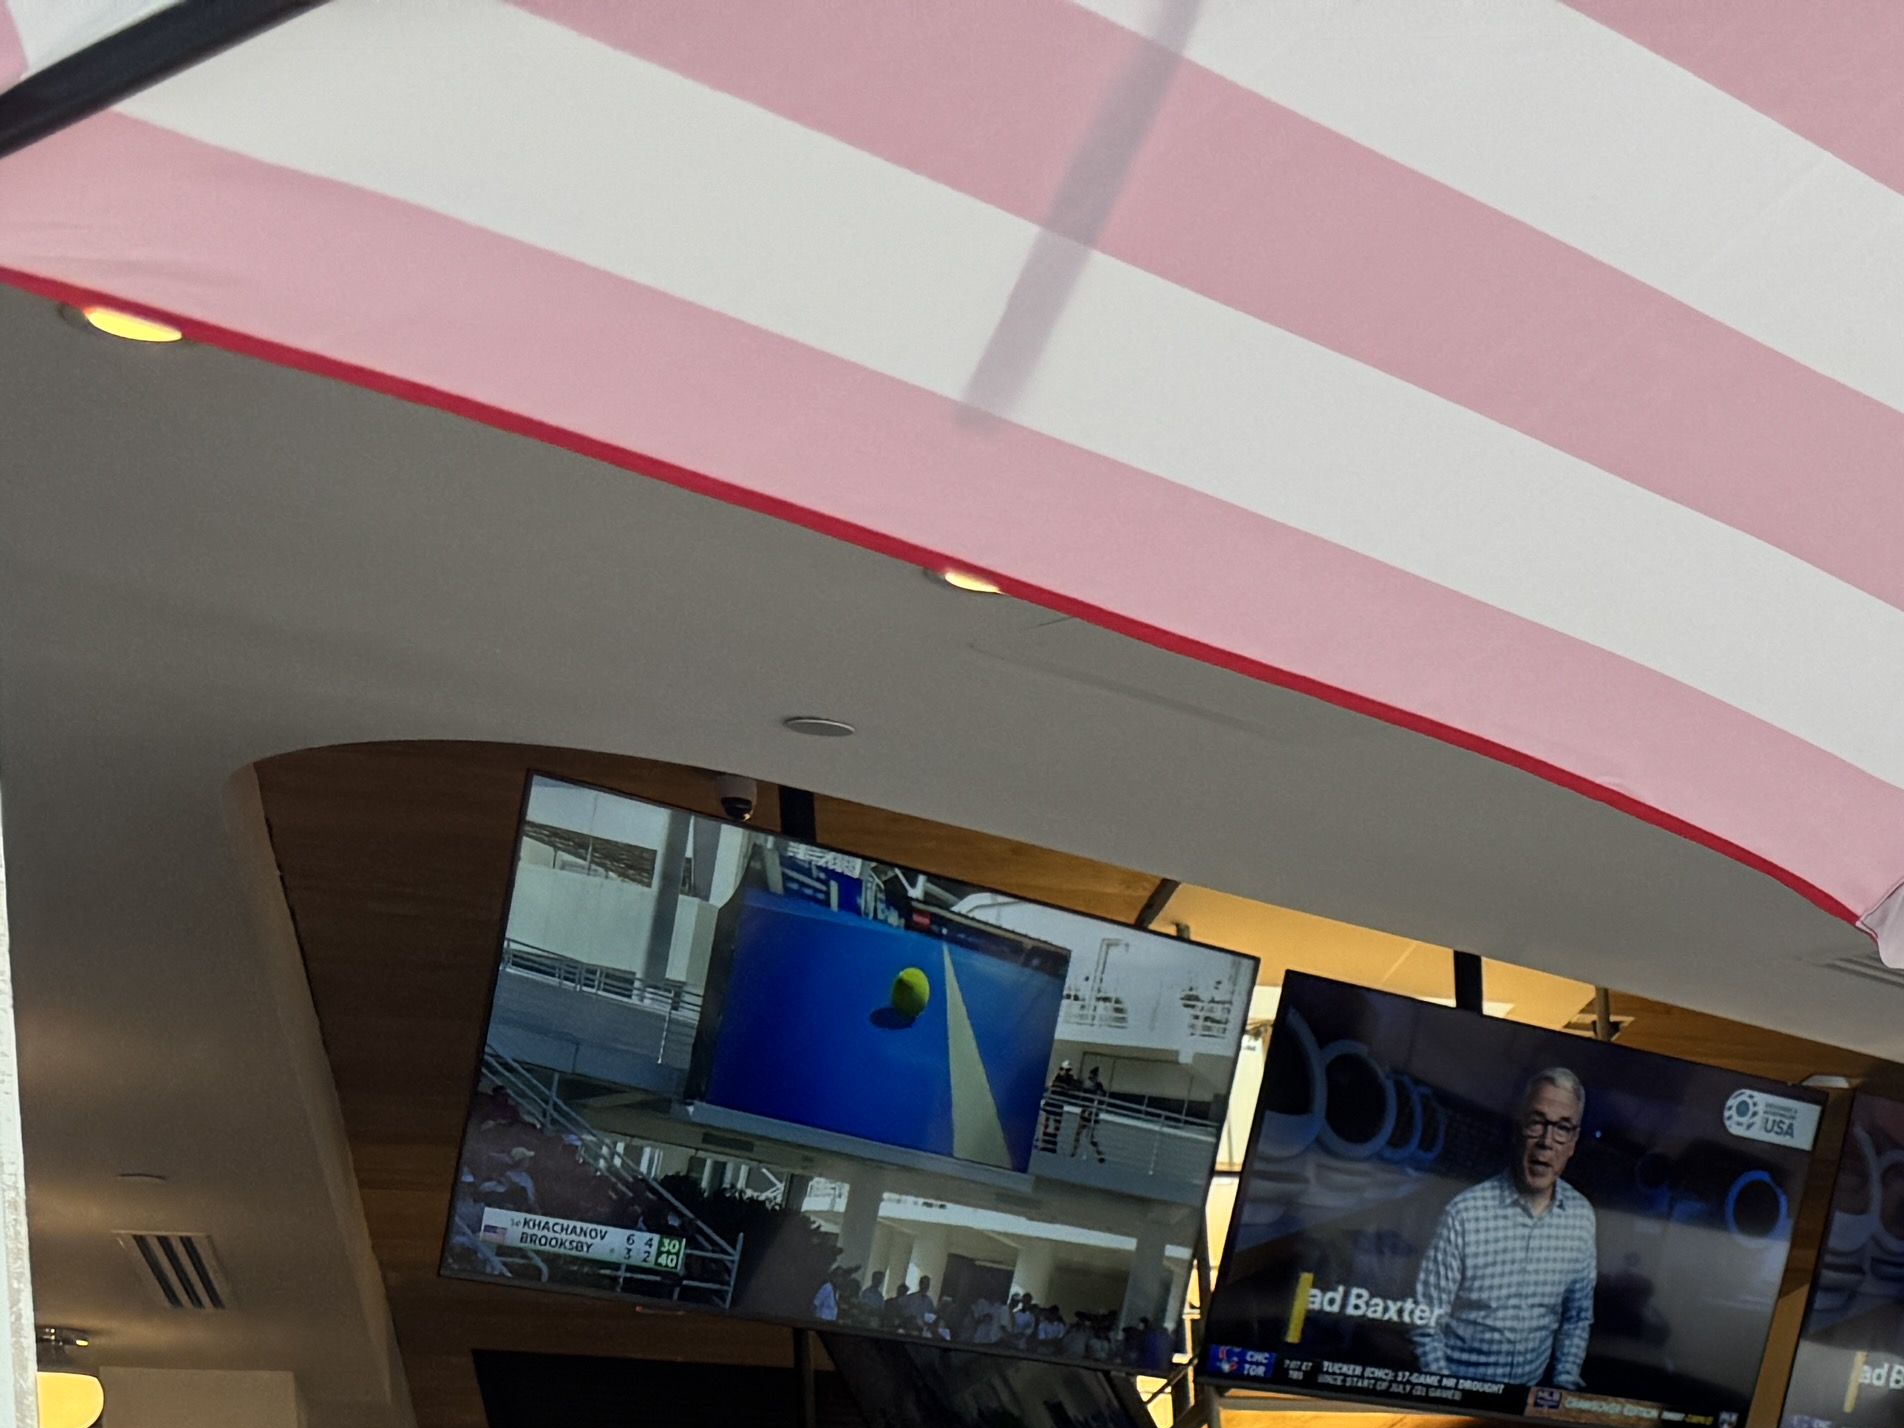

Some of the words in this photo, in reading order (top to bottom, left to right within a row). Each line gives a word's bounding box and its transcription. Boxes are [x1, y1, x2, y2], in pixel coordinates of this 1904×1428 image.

[1764, 1118, 1795, 1139] USA
[519, 1231, 594, 1255] BROOKSBY
[623, 1248, 633, 1261] 3
[641, 1250, 651, 1263] 2
[657, 1254, 677, 1268] 40
[522, 1217, 608, 1241] KHACHANOV
[626, 1233, 635, 1246] 6
[644, 1237, 654, 1249] 4
[660, 1238, 680, 1253] 30
[1347, 1287, 1445, 1327] Baxter
[1245, 1350, 1269, 1364] CHC
[1322, 1361, 1363, 1376] TUCKER
[1457, 1377, 1505, 1395] DROUGHT
